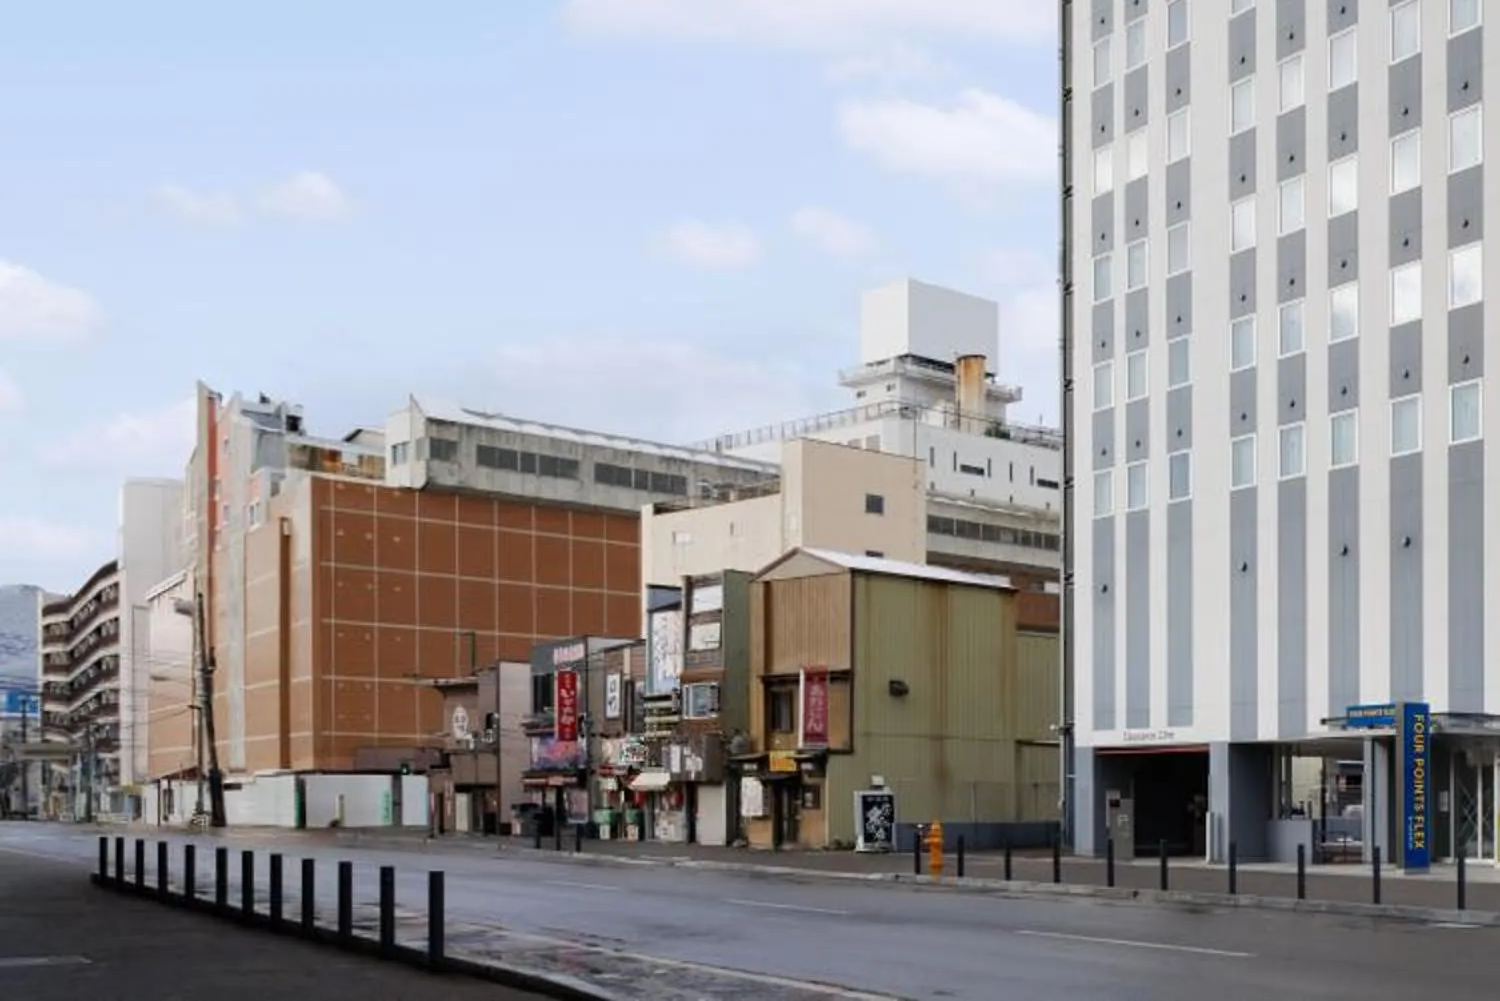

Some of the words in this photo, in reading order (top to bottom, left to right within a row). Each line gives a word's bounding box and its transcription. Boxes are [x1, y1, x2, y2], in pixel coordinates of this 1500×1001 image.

[1413, 713, 1424, 752] FOUR
[1413, 758, 1425, 811] POINTS
[1413, 815, 1425, 848] FLEX
